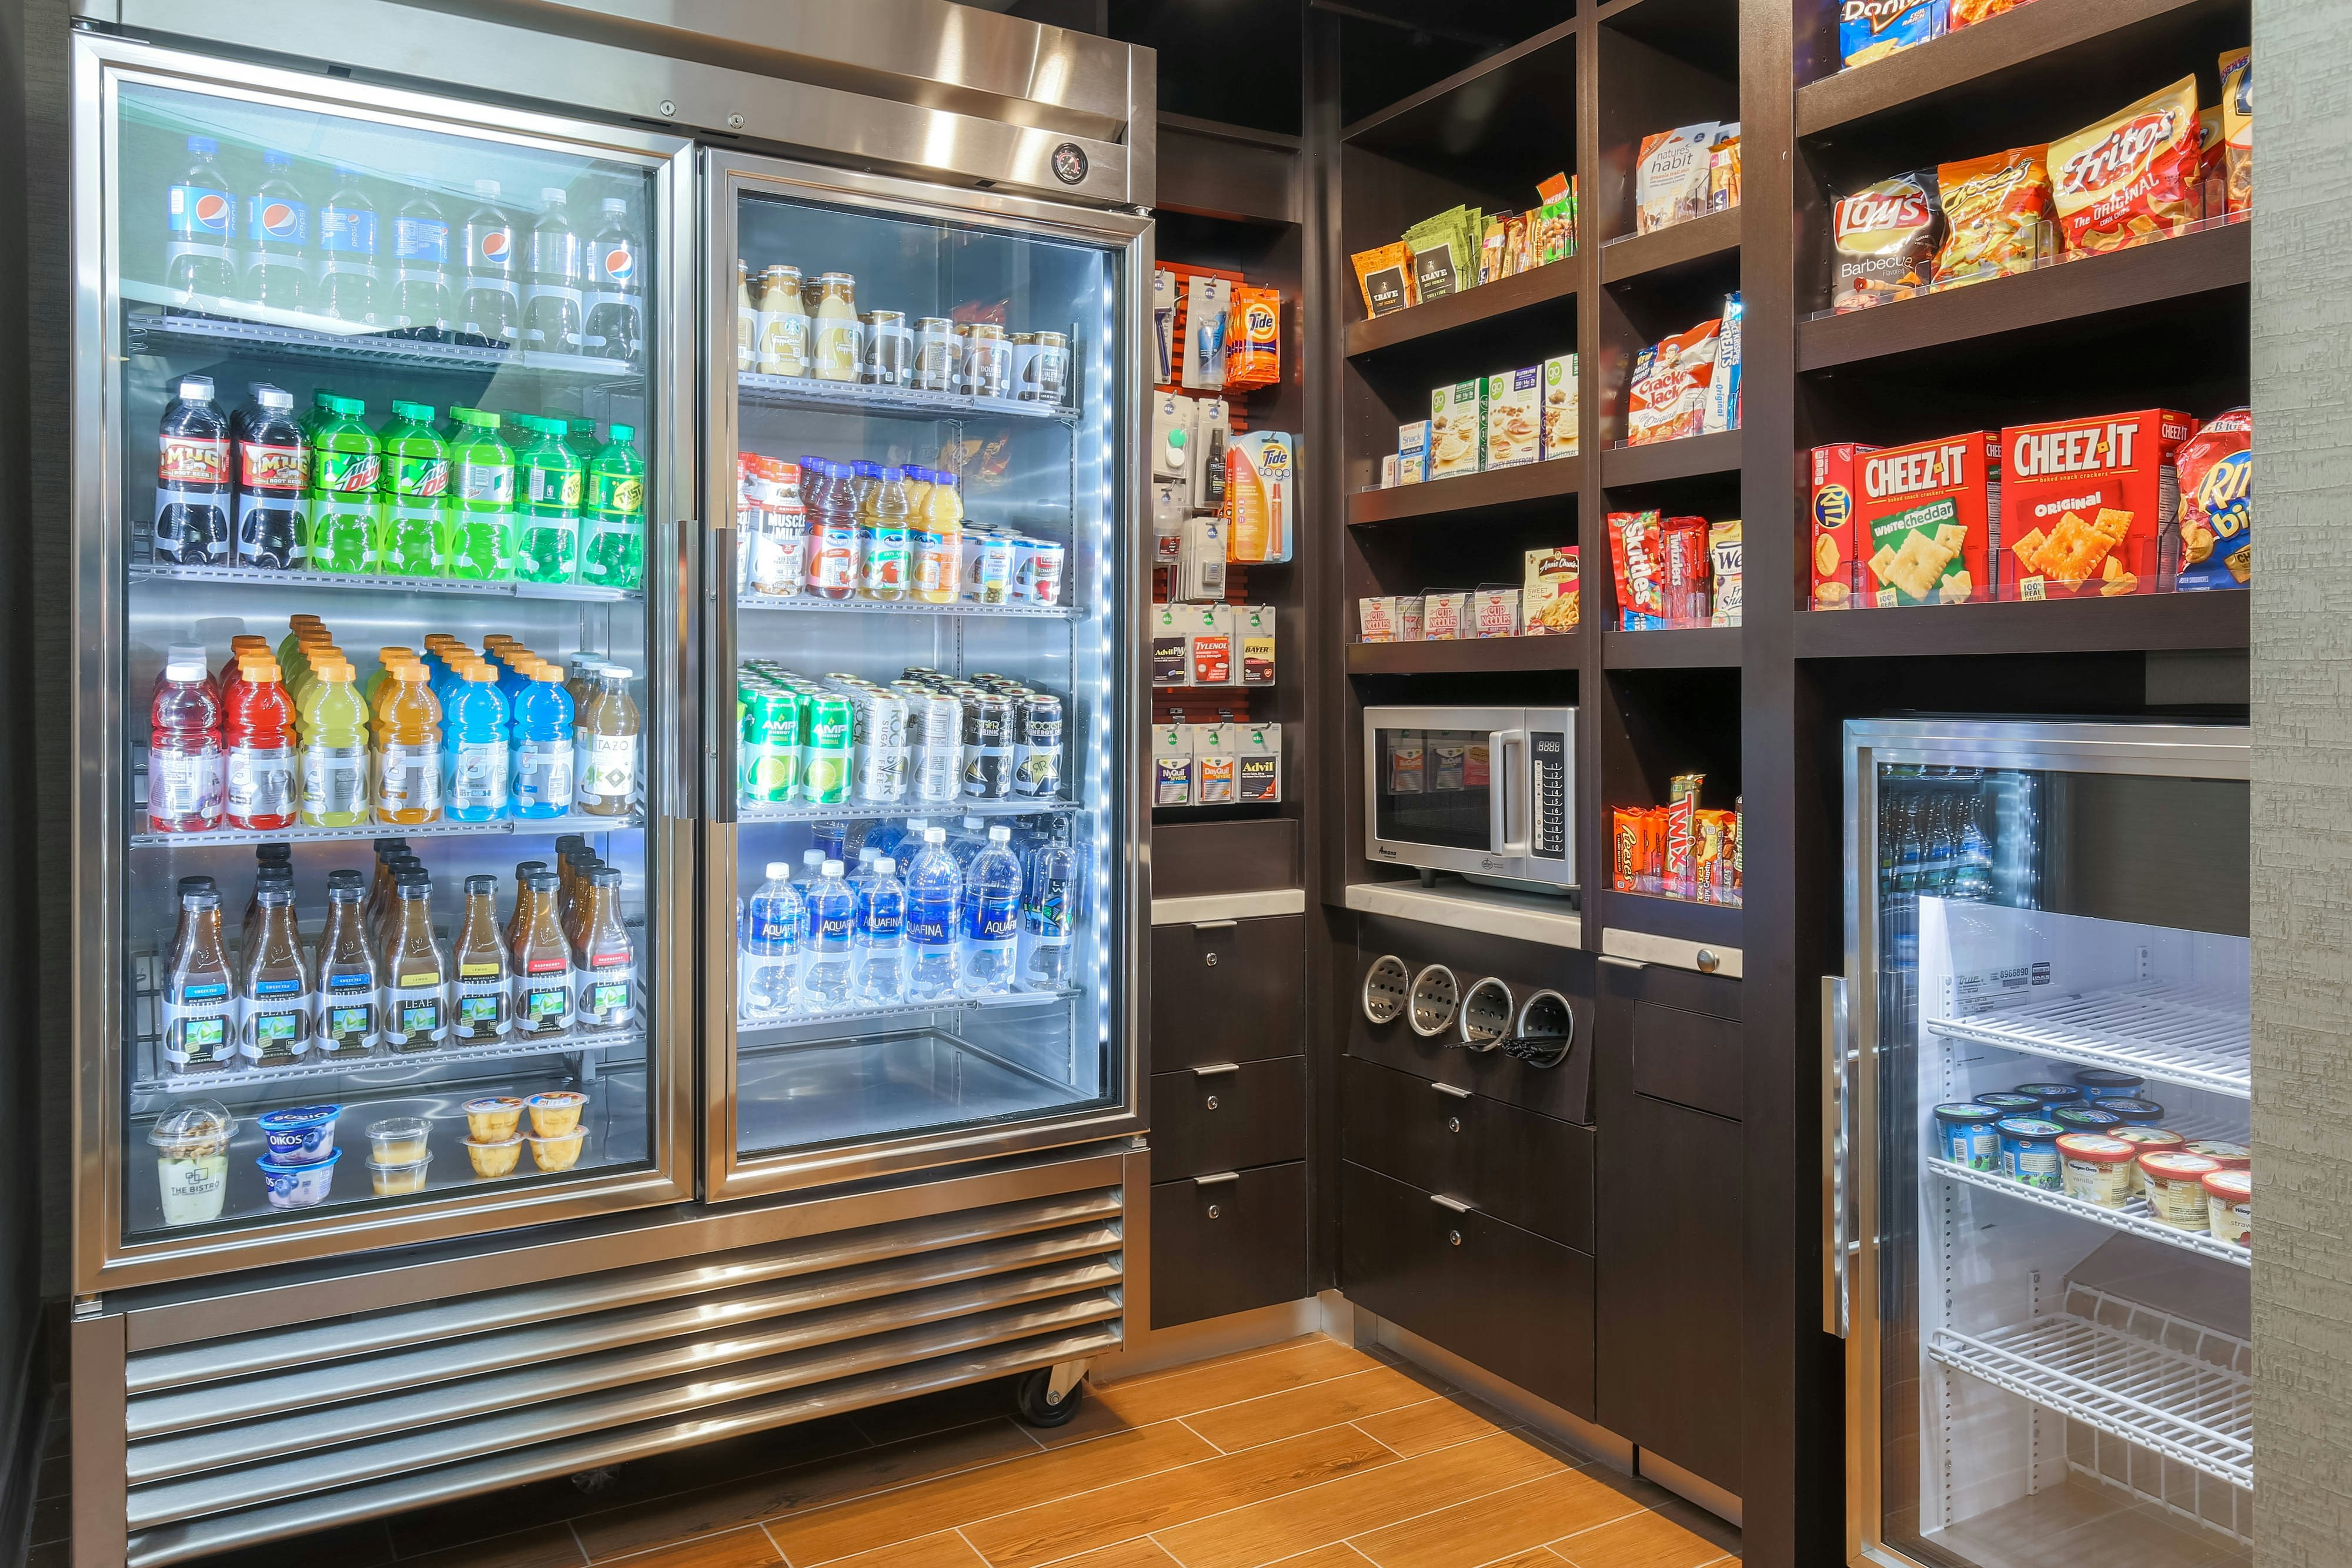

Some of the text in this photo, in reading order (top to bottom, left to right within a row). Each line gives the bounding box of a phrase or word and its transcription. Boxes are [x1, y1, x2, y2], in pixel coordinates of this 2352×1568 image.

[2063, 111, 2175, 195] Fritos
[1651, 153, 1693, 174] habit
[1670, 169, 1681, 177] trail
[2074, 172, 2160, 229] The ORIGINAL
[1839, 193, 1922, 238] Lay's
[2100, 206, 2130, 226] CORN CHIPS
[1842, 256, 1913, 278] Barbecue
[1883, 268, 1905, 277] Flavored
[1421, 269, 1448, 283] KRAVE
[1373, 290, 1398, 302] KRAVE
[1249, 313, 1273, 332] Tide
[1719, 320, 1732, 369] TREATS
[1548, 366, 1559, 380] go
[1633, 362, 1650, 376] PRIZE
[1491, 382, 1502, 396] go
[1434, 396, 1444, 408] go
[1646, 386, 1680, 410] Jack
[1715, 385, 1724, 417] Original
[1402, 433, 1421, 444] Snack
[167, 447, 219, 468] MUG
[261, 456, 309, 473] MUG
[1263, 450, 1288, 467] Tide
[1258, 466, 1290, 481] to go
[2080, 471, 2109, 479] crackers
[1920, 490, 1945, 499] crackers
[1819, 487, 1846, 526] RITZ
[768, 513, 806, 527] MUSCLE
[1905, 501, 1953, 529] cheddar
[776, 528, 803, 540] MILK
[1540, 558, 1578, 573] Annie Chun's
[1625, 522, 1652, 605] Skittles
[1670, 531, 1681, 586] Twizzlers
[1370, 611, 1385, 620] CUP
[1436, 608, 1453, 617] CUP
[1487, 605, 1505, 615] CUP
[1365, 619, 1390, 630] NOODLES
[1429, 617, 1457, 627] NOODLES
[1481, 614, 1511, 626] NOODLES
[1195, 642, 1227, 651] TYLENOL
[762, 721, 797, 730] AMP
[813, 724, 847, 734] AMP
[878, 720, 889, 754] SUGAR
[596, 740, 629, 751] TAZO
[459, 749, 489, 779] G
[1242, 762, 1274, 772] Advil
[1163, 768, 1185, 777] NyQuil
[1669, 791, 1696, 872] TWIX
[1379, 846, 1396, 855] Amana
[1622, 825, 1637, 884] Reese's
[1704, 861, 1712, 888] Crunchy
[863, 915, 903, 927] AQUAFINA
[2000, 968, 2029, 978] 8966890
[405, 1000, 432, 1009] LEAF
[270, 1134, 302, 1145] OIKOS
[190, 1181, 219, 1193] BISTRO
[2073, 1176, 2093, 1185] vanilla
